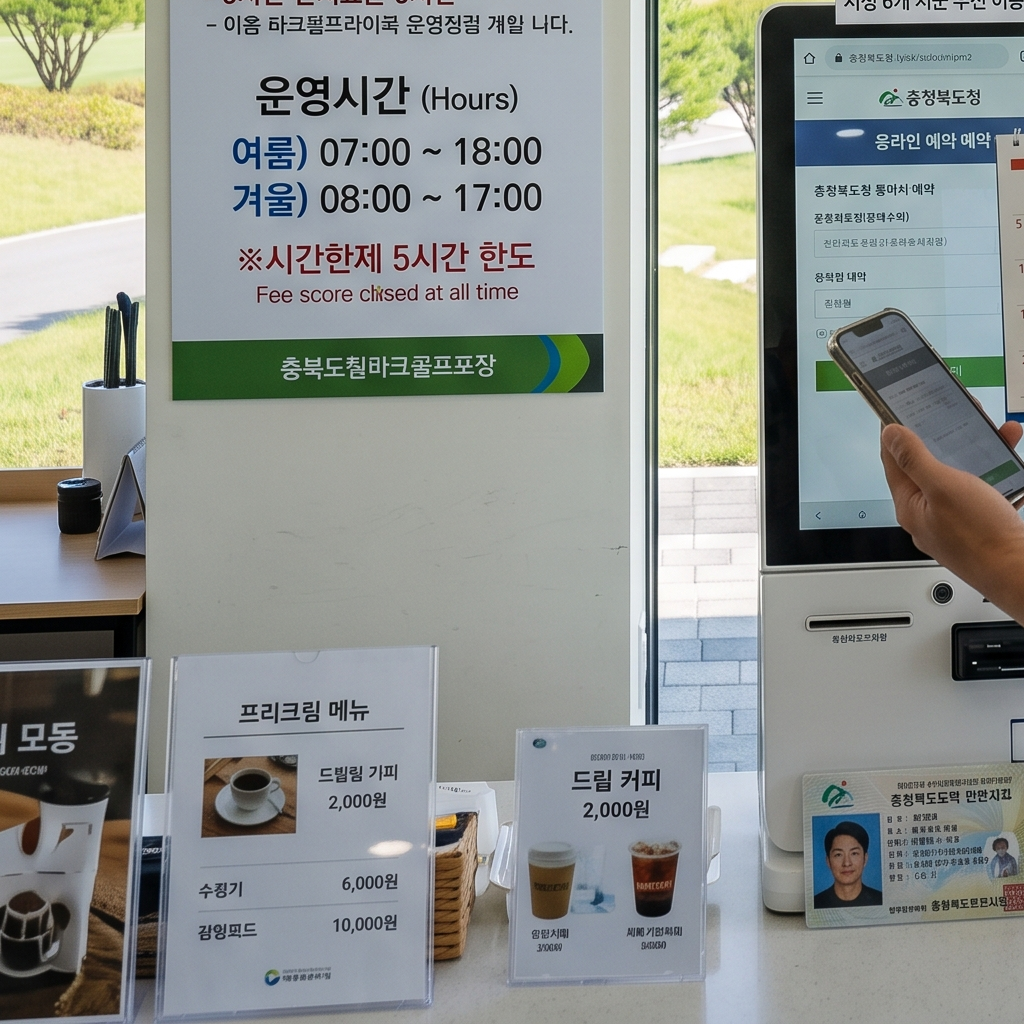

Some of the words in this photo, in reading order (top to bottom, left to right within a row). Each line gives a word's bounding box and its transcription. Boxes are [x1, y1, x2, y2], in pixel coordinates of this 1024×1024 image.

[256, 76, 410, 116] 운영시간
[422, 84, 517, 114] (Hours)
[321, 138, 410, 166] 07:00
[455, 137, 541, 165] 18:00
[233, 182, 307, 218] 겨울)
[321, 184, 410, 213] 08:00
[455, 183, 541, 211] 17:00
[1016, 219, 1022, 228] 5
[394, 243, 469, 273] 5시간
[480, 242, 535, 271] 한도
[258, 286, 292, 303] Fee
[300, 285, 352, 302] score
[426, 285, 443, 300] at
[450, 283, 469, 300] all
[476, 283, 518, 300] time
[239, 701, 320, 724] 프리크림
[329, 700, 369, 721] 메뉴
[18, 722, 78, 753] 모동
[572, 770, 611, 792] 드립
[621, 769, 660, 791] 커피
[329, 792, 386, 811] 2,000원
[584, 800, 649, 821] 2,000원
[342, 874, 397, 893] 6,000원
[333, 915, 397, 934] 10,000원
